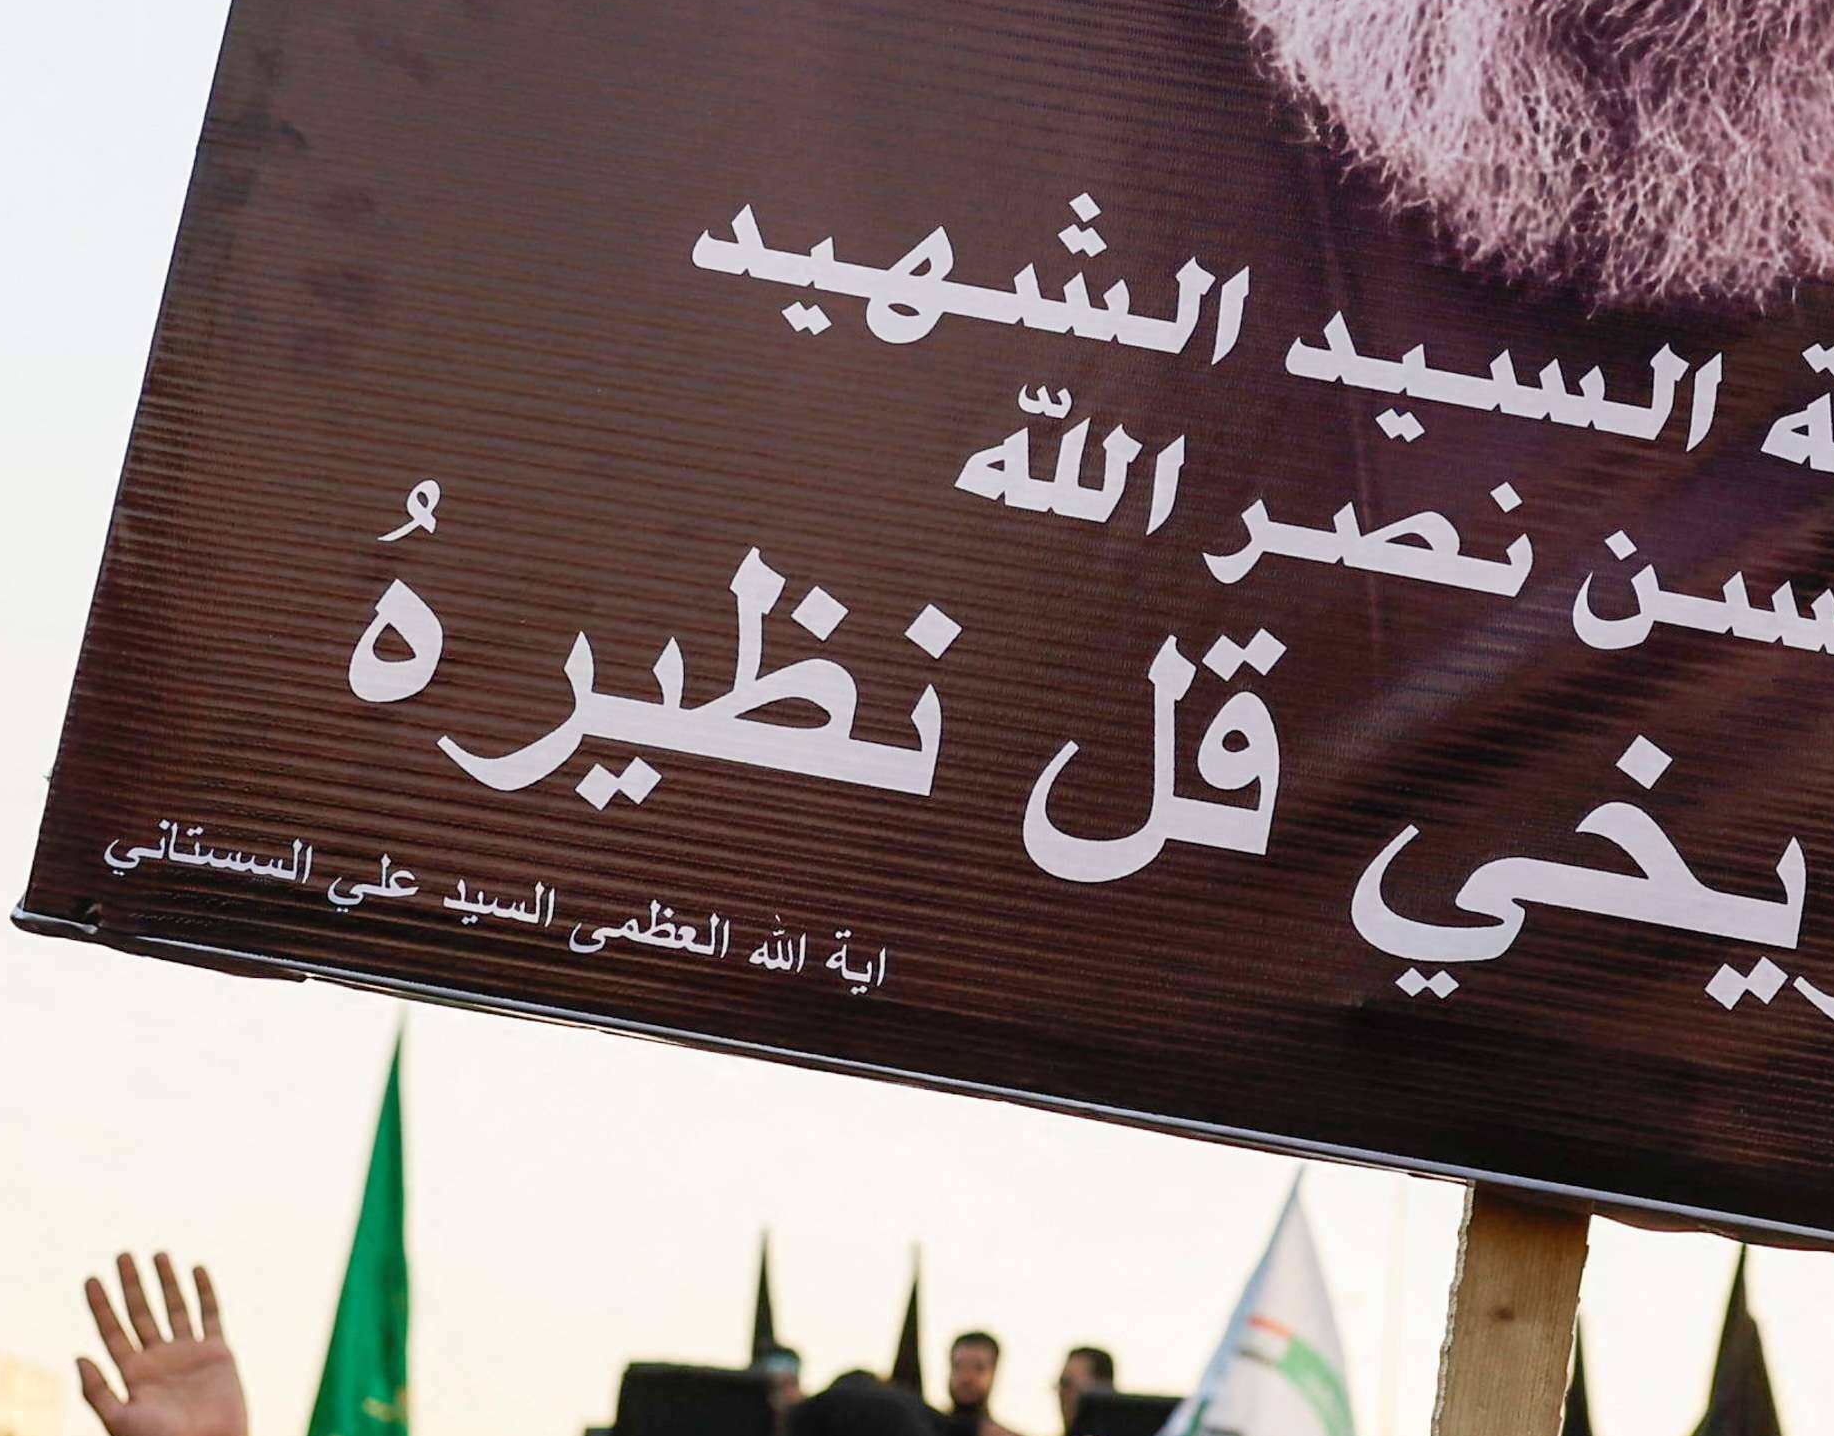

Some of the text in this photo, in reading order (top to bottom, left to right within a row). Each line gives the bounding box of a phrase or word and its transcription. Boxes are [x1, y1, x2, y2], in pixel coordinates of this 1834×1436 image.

[692, 193, 1250, 365] الشهيد
[1285, 310, 1722, 452] السيد
[1202, 483, 1533, 597] نصر
[1023, 629, 1287, 883] قل
[104, 819, 313, 884] السستاني
[327, 853, 419, 914] علي
[443, 879, 555, 928] السيد
[569, 899, 731, 959] العظمى
[825, 929, 887, 995] اية
